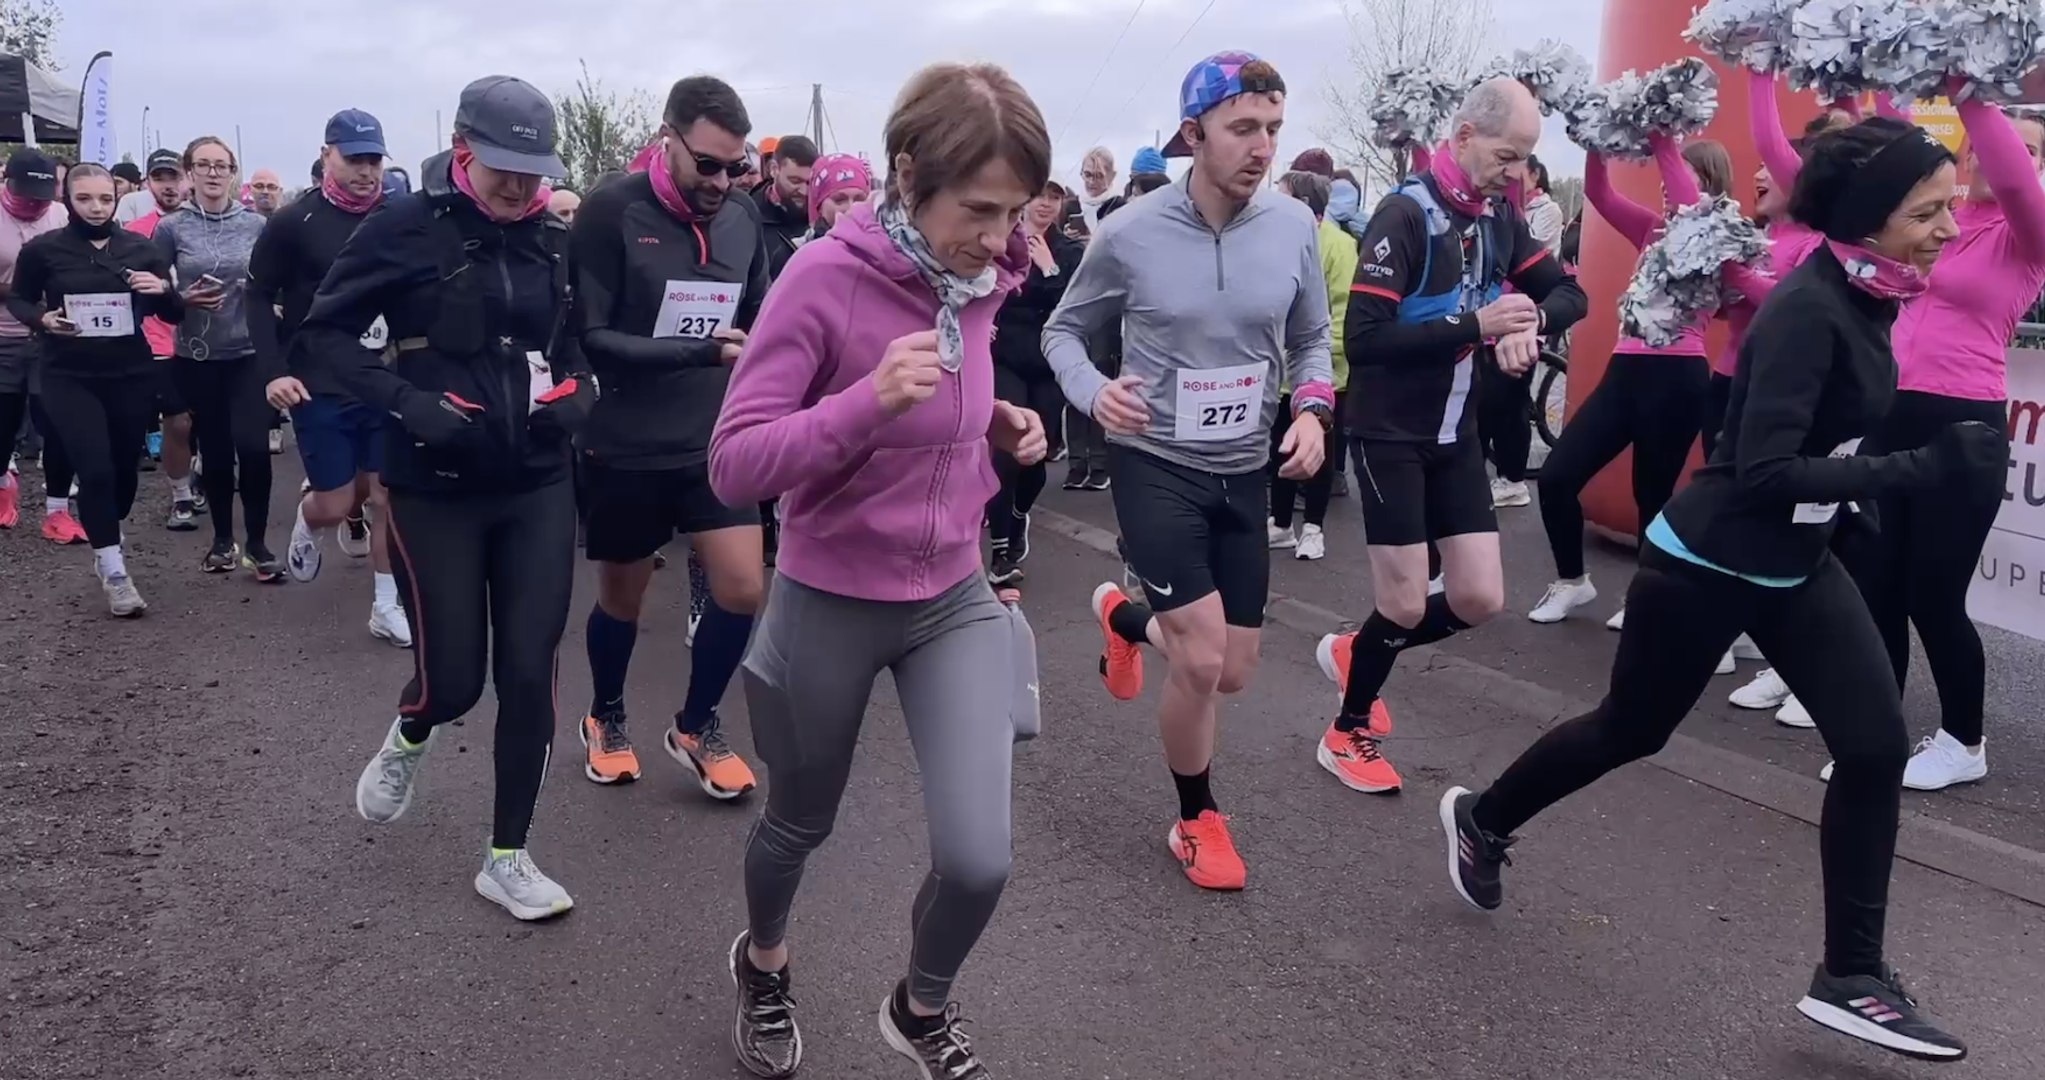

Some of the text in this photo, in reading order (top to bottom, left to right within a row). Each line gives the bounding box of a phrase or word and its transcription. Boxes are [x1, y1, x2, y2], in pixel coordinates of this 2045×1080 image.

[669, 292, 696, 302] ROSE
[710, 293, 735, 303] ROLL
[91, 316, 113, 328] 15
[679, 317, 721, 337] 237
[1183, 381, 1217, 392] ROSE
[1236, 375, 1261, 387] ROLL
[1202, 403, 1248, 426] 272
